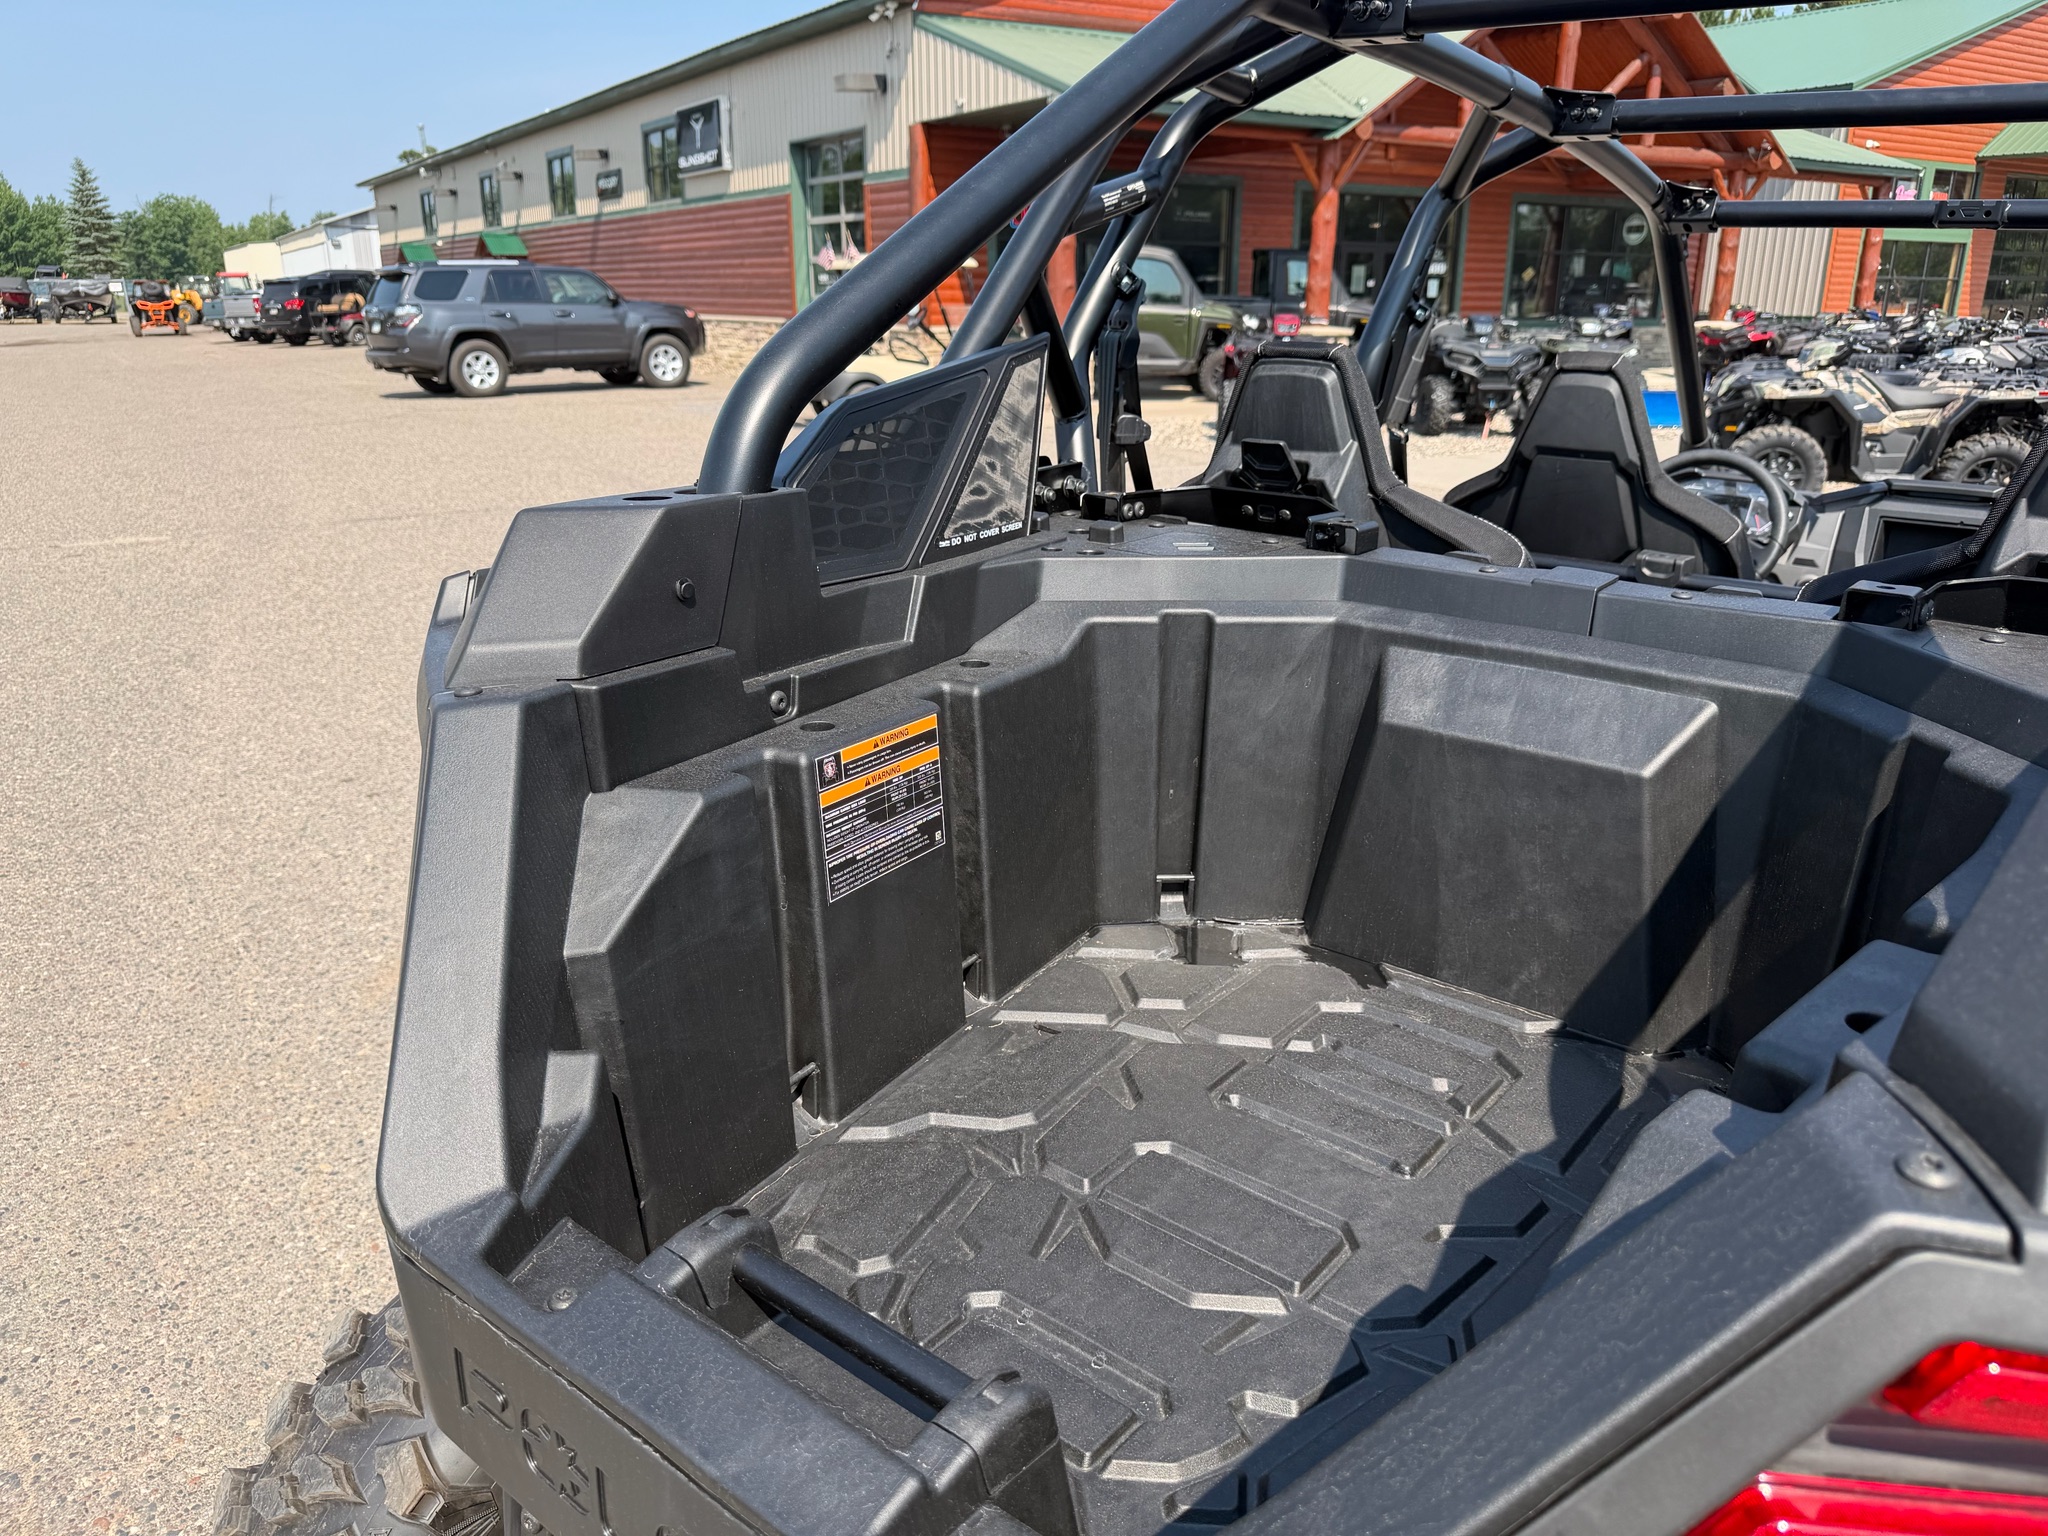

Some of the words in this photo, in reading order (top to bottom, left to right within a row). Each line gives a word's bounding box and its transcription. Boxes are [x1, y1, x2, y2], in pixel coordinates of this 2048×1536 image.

[951, 538, 962, 546] DO
[964, 533, 977, 543] NOT
[979, 527, 1000, 539] COVER
[1001, 521, 1022, 533] SCREEN
[879, 728, 909, 746] WARNING
[871, 765, 901, 783] WARNING
